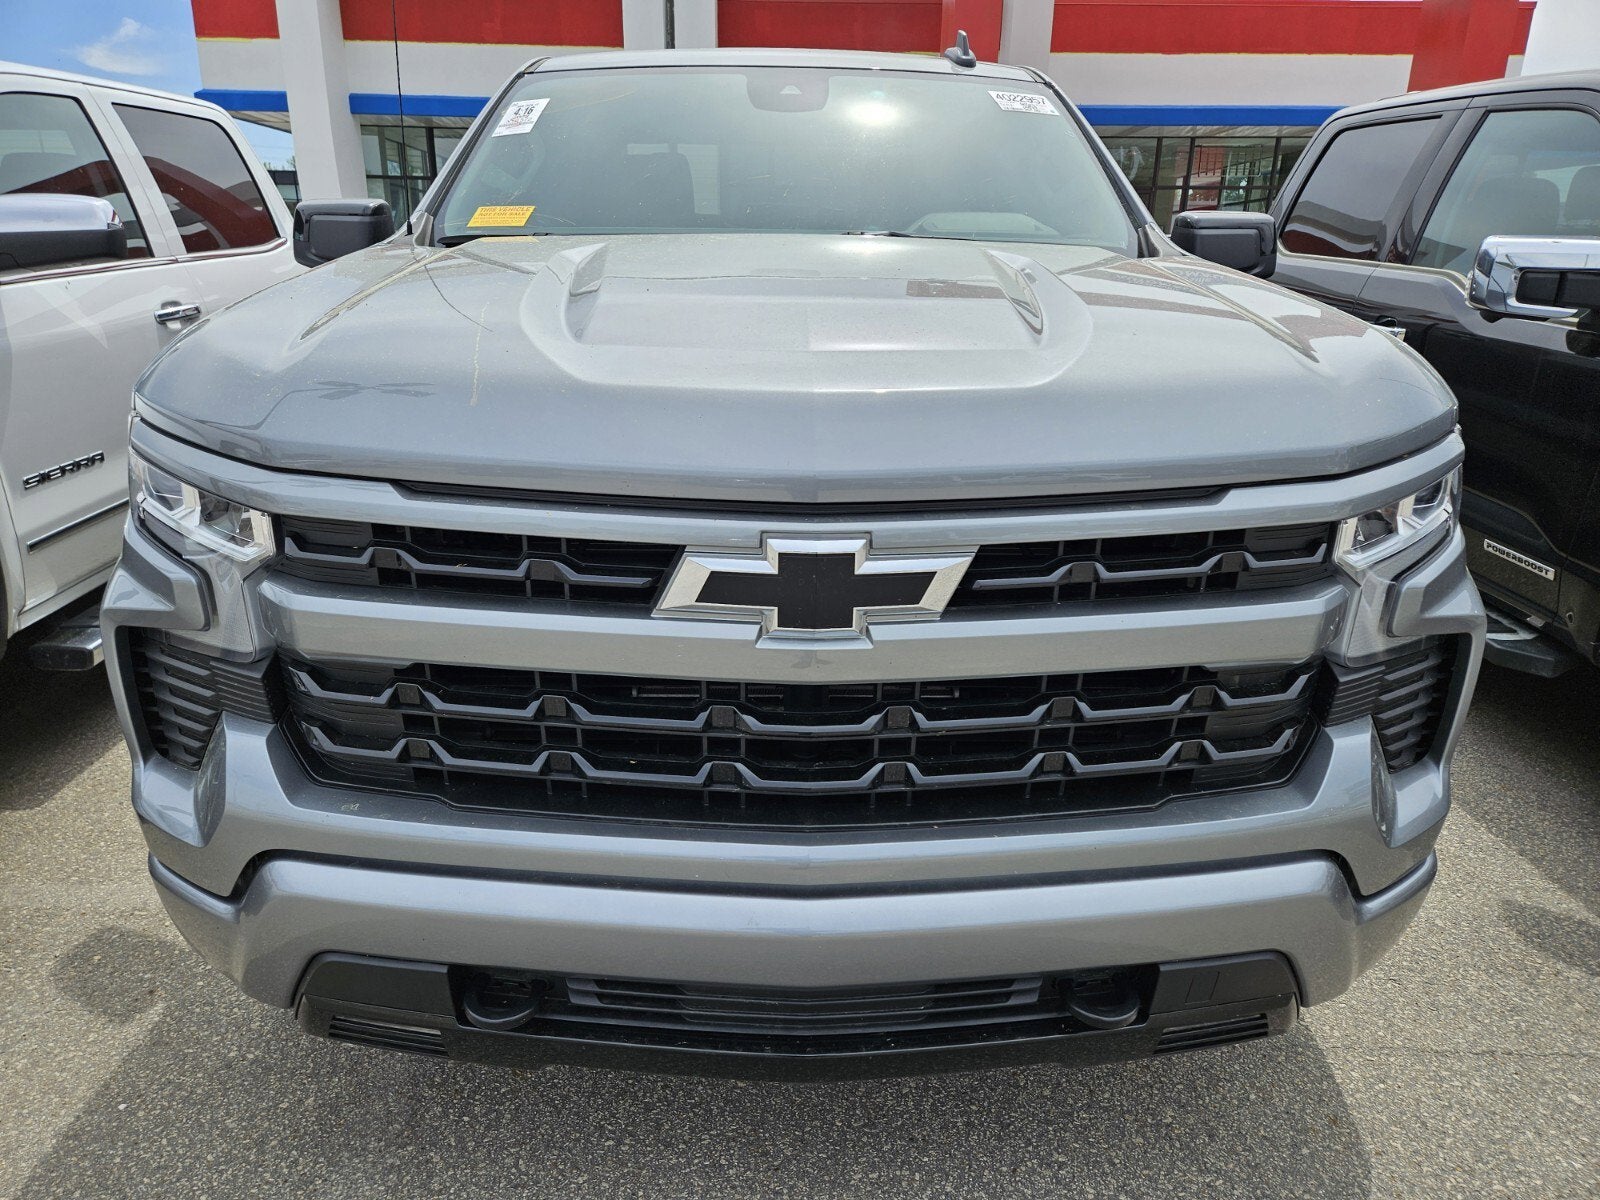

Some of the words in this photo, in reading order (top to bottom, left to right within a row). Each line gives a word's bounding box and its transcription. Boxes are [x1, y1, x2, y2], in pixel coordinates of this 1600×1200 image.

[996, 93, 1046, 105] 4022957
[23, 450, 105, 490] SIERRA
[1486, 542, 1550, 576] POWERBOOST
